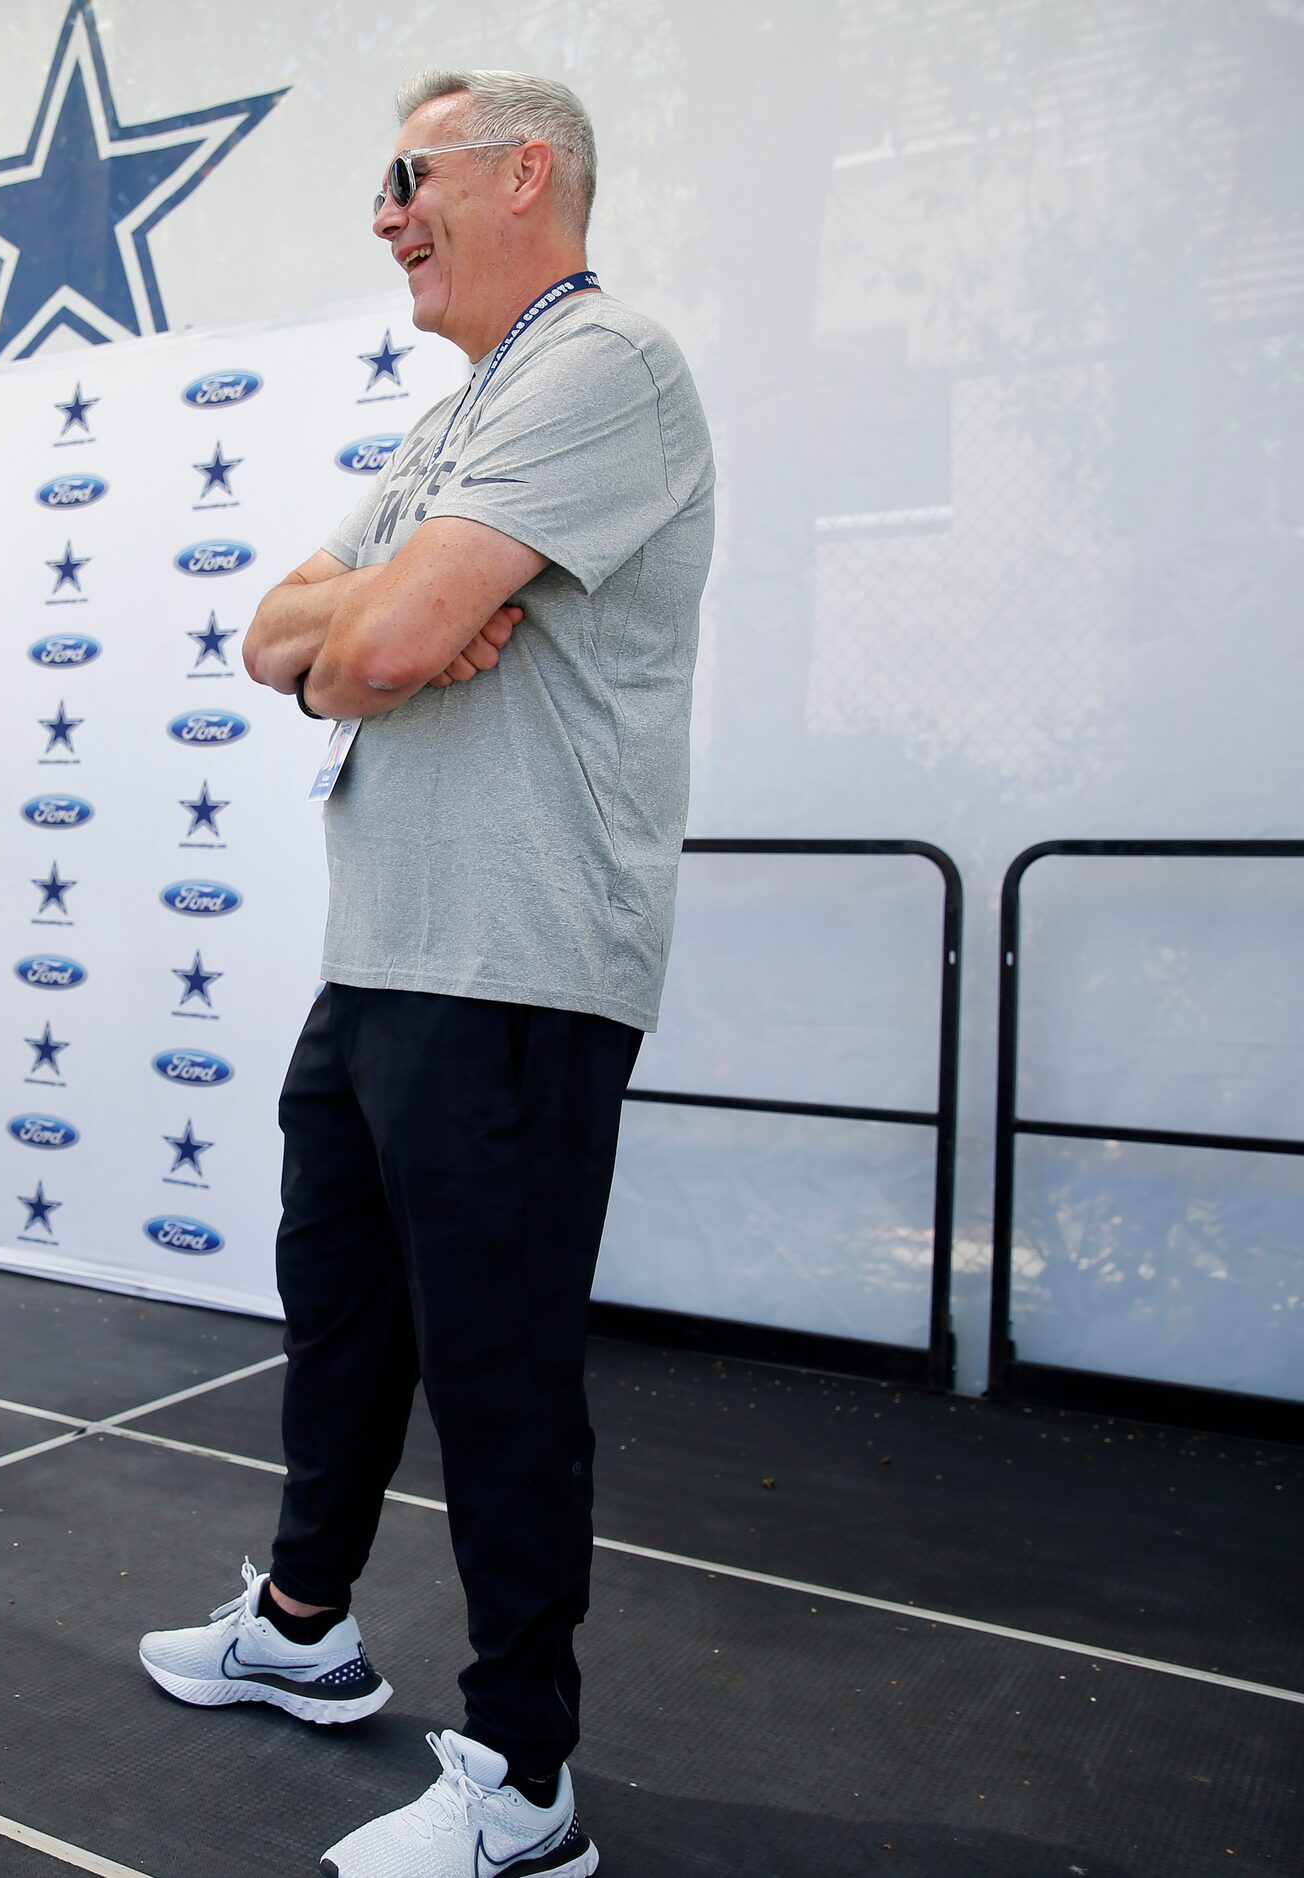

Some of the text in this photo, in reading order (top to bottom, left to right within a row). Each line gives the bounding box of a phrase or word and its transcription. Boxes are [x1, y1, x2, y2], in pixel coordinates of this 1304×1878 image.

[491, 281, 575, 369] DALLAS COWBOYS
[196, 375, 248, 405] Ford
[352, 442, 393, 468] For
[49, 478, 97, 505] Ford
[188, 544, 239, 573] Ford
[41, 638, 88, 664] Ford
[181, 714, 234, 742] Ford
[33, 799, 80, 825] Ford
[175, 885, 226, 911] Ford
[26, 959, 75, 986] Ford
[166, 1051, 217, 1083] Ford
[19, 1118, 68, 1145] Ford
[158, 1219, 209, 1252] Ford
